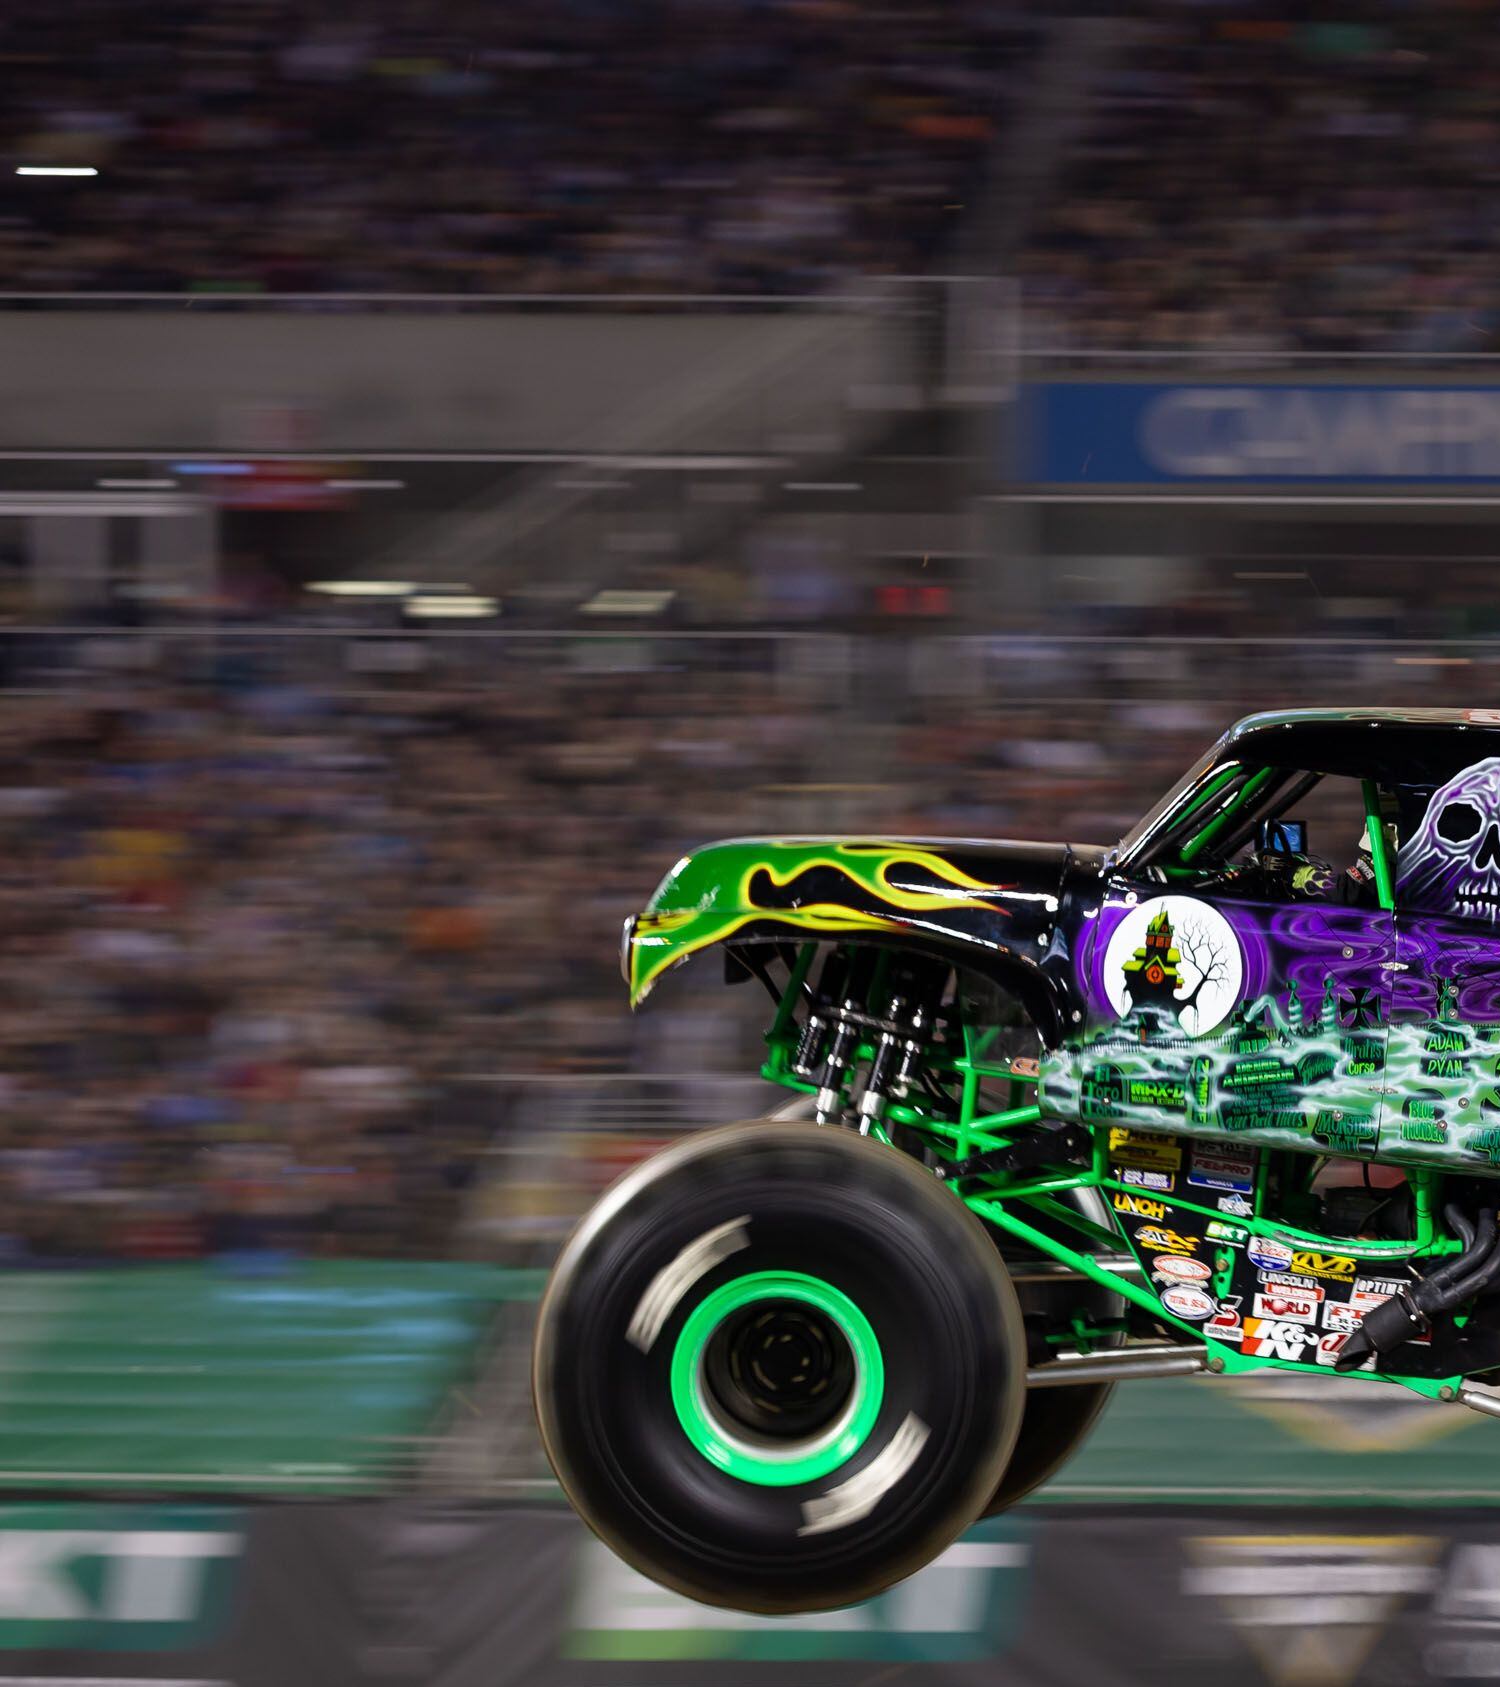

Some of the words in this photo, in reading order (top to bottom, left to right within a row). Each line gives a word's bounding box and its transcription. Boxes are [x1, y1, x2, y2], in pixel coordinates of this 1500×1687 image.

[1427, 1031, 1465, 1051] ADAM
[1347, 1061, 1375, 1076] Curse
[1130, 1080, 1185, 1099] MAX-D
[1408, 1100, 1435, 1120] BLUE
[1318, 1111, 1373, 1136] MONSTER
[1400, 1120, 1445, 1143] THUNDER
[1114, 1192, 1166, 1219] UNOH
[1207, 1221, 1249, 1241] BKT
[1261, 1271, 1314, 1289] LINCOLN
